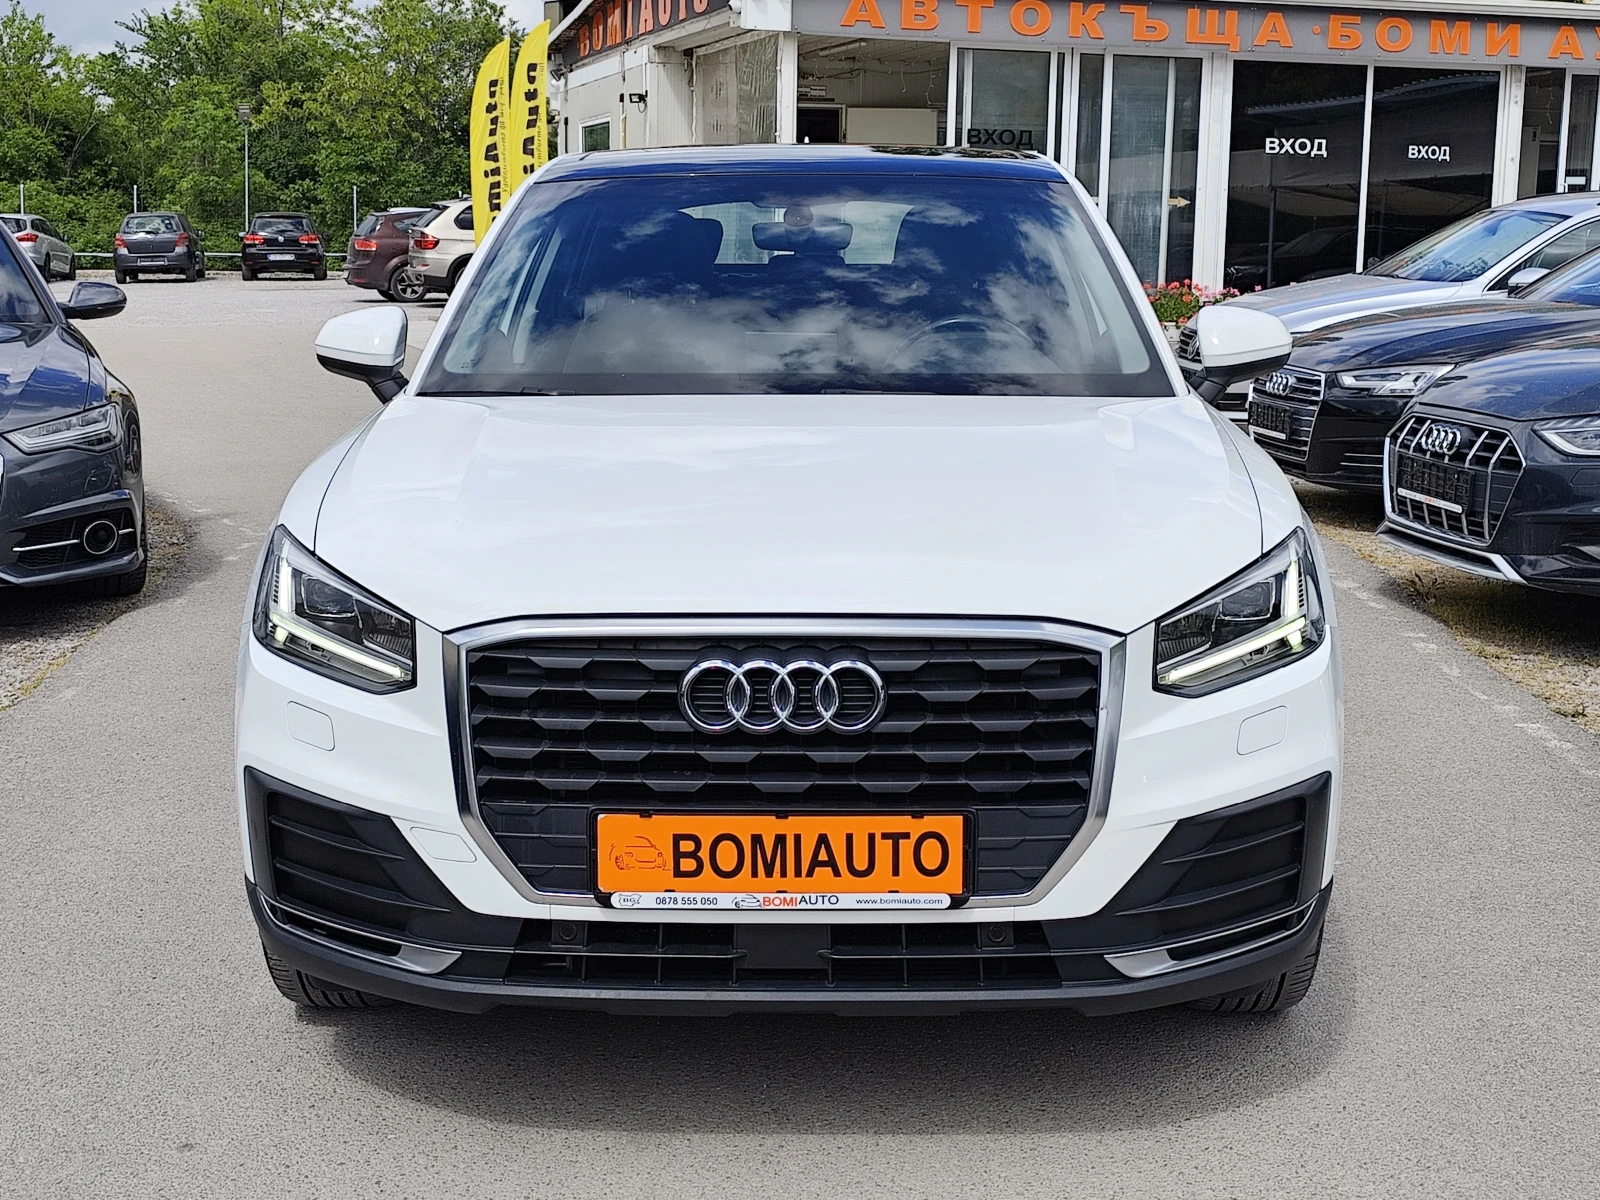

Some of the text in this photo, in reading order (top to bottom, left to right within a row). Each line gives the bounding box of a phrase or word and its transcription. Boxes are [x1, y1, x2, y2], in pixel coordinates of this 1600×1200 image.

[577, 0, 708, 57] BOMIAU
[1327, 14, 1521, 57] БОМИ
[1547, 25, 1600, 60] А
[484, 79, 501, 223] miAuto
[967, 129, 1034, 149] ВХОД
[1265, 138, 1328, 157] ВХОД
[1408, 145, 1450, 162] ВХОД
[671, 831, 951, 879] BOMIAUTO
[655, 896, 718, 906] 0878 555 050
